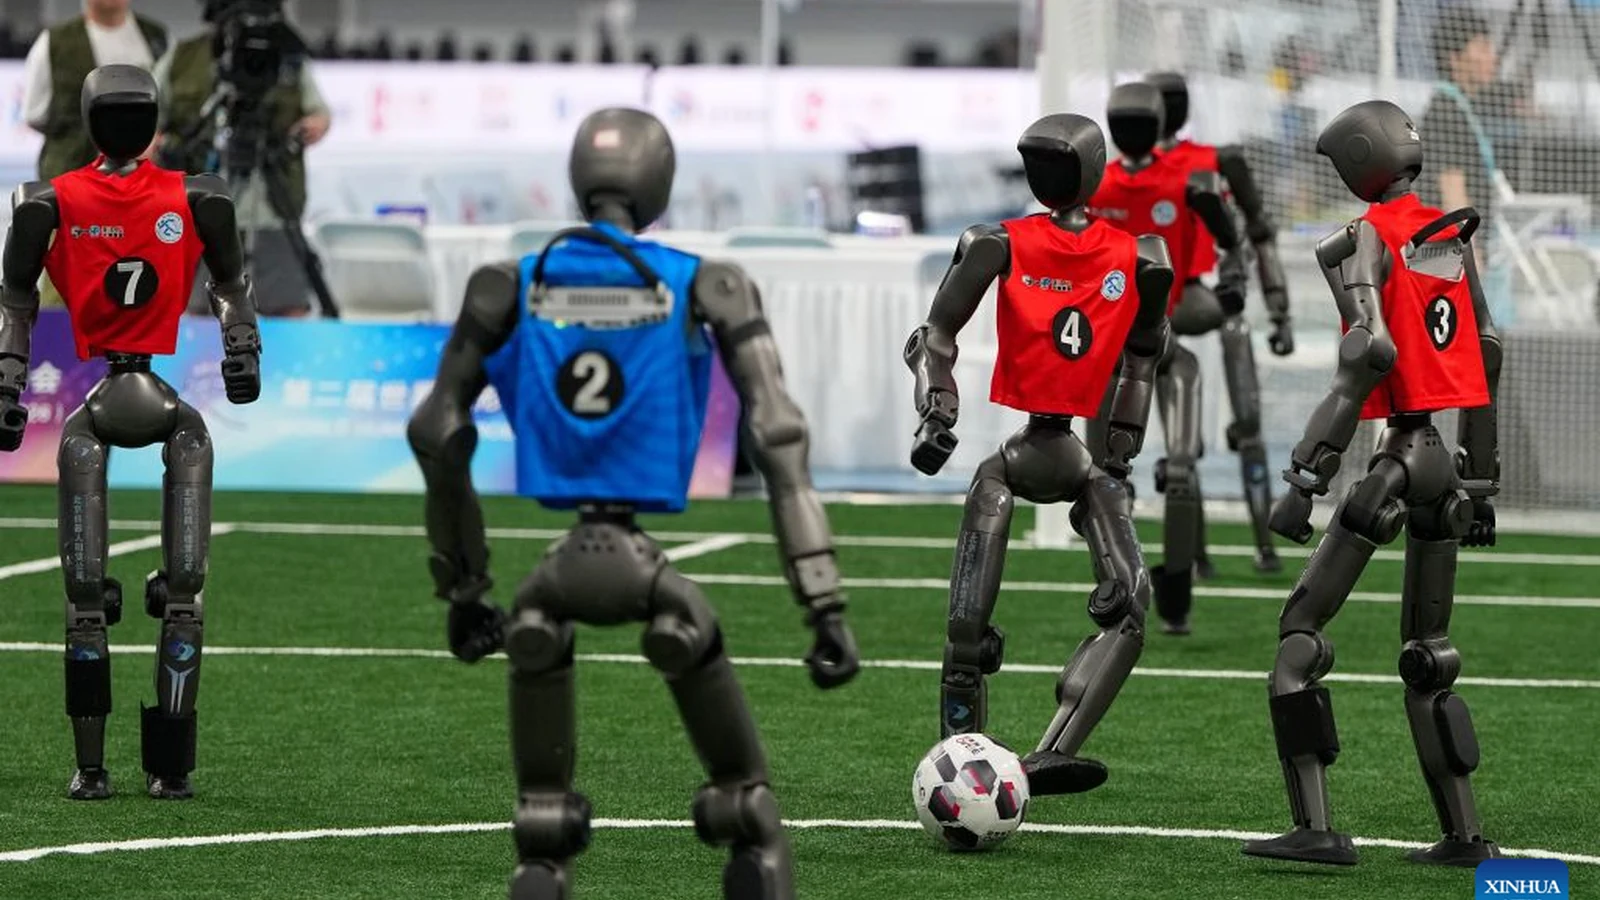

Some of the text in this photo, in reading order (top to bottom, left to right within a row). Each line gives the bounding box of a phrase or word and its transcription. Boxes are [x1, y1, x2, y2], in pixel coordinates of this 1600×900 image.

[117, 261, 144, 305] 7
[1060, 310, 1082, 355] 4
[1434, 298, 1451, 344] 3
[571, 351, 612, 413] 2
